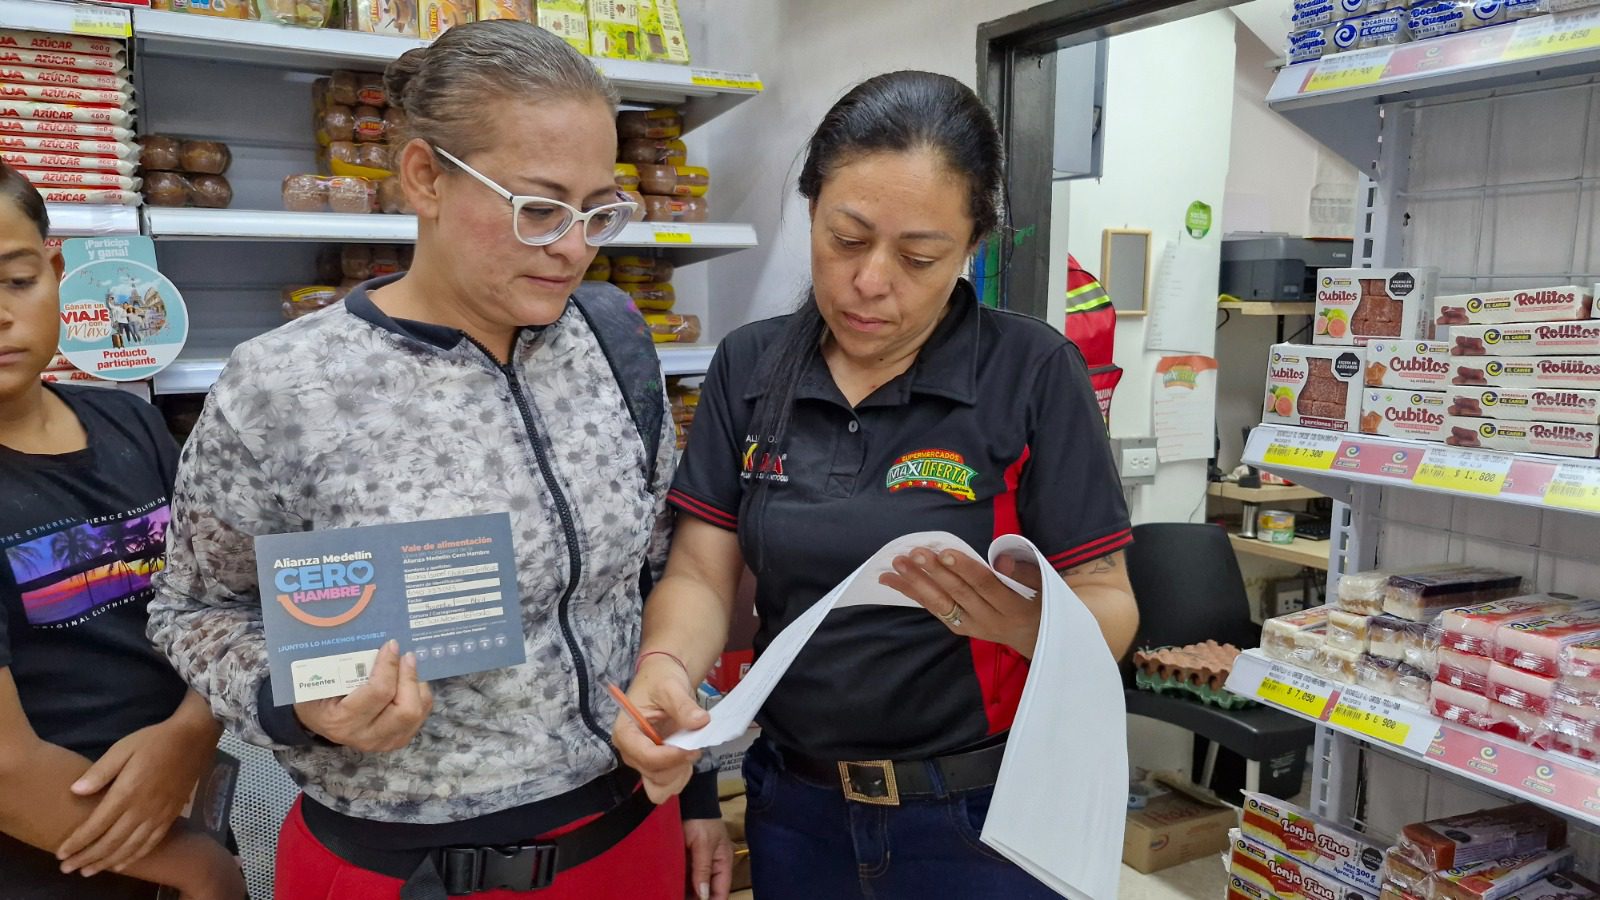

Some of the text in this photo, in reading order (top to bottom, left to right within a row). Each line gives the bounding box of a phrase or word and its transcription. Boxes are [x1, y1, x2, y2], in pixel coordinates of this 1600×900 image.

[1300, 4, 1334, 19] Guayaba
[1421, 12, 1464, 27] Guayaba
[31, 37, 73, 49] AZÚCAR
[35, 53, 76, 66] AZÚCAR
[38, 71, 79, 84] AZÚCAR
[41, 88, 82, 100] AZÚCAR
[33, 107, 73, 120] AZÚCAR
[37, 122, 78, 133] AZÚCAR
[39, 139, 80, 150] AZÚCAR
[40, 155, 81, 166] AZÚCAR
[42, 173, 83, 183] AZÚCAR
[46, 191, 87, 202] AZÚCAR
[85, 239, 130, 250] ¡Participa
[88, 247, 129, 260] y gana!
[1318, 291, 1358, 301] Cubitos
[1514, 290, 1575, 306] Rollitos
[60, 309, 110, 324] VIAJE
[67, 323, 110, 339] Maxi
[1535, 324, 1600, 340] Rollitos
[103, 348, 147, 359] Producto
[97, 356, 156, 370] participante
[1390, 356, 1450, 373] Cubitos
[1537, 360, 1600, 375] Rollitos
[1532, 392, 1596, 409] Rollitos
[1385, 406, 1445, 425] Cubitos
[1530, 424, 1594, 442] Rollitos
[901, 452, 960, 462] SUPERMERCADOS
[0, 532, 21, 544] THE
[26, 516, 76, 536] ETHEREAL
[401, 544, 422, 553] Vale
[437, 536, 493, 549] alimentación
[274, 550, 373, 569] Alianza Medellín
[274, 560, 375, 593] CERO
[293, 585, 361, 604] HAMBRE
[92, 595, 136, 617] CLOTHING
[321, 636, 356, 646] HACEMOS
[299, 678, 336, 689] Presentes
[1287, 686, 1292, 695] $
[1282, 817, 1350, 857] Lonja Fina
[1268, 859, 1334, 900] Lonja Fina
[1356, 868, 1371, 878] 300
